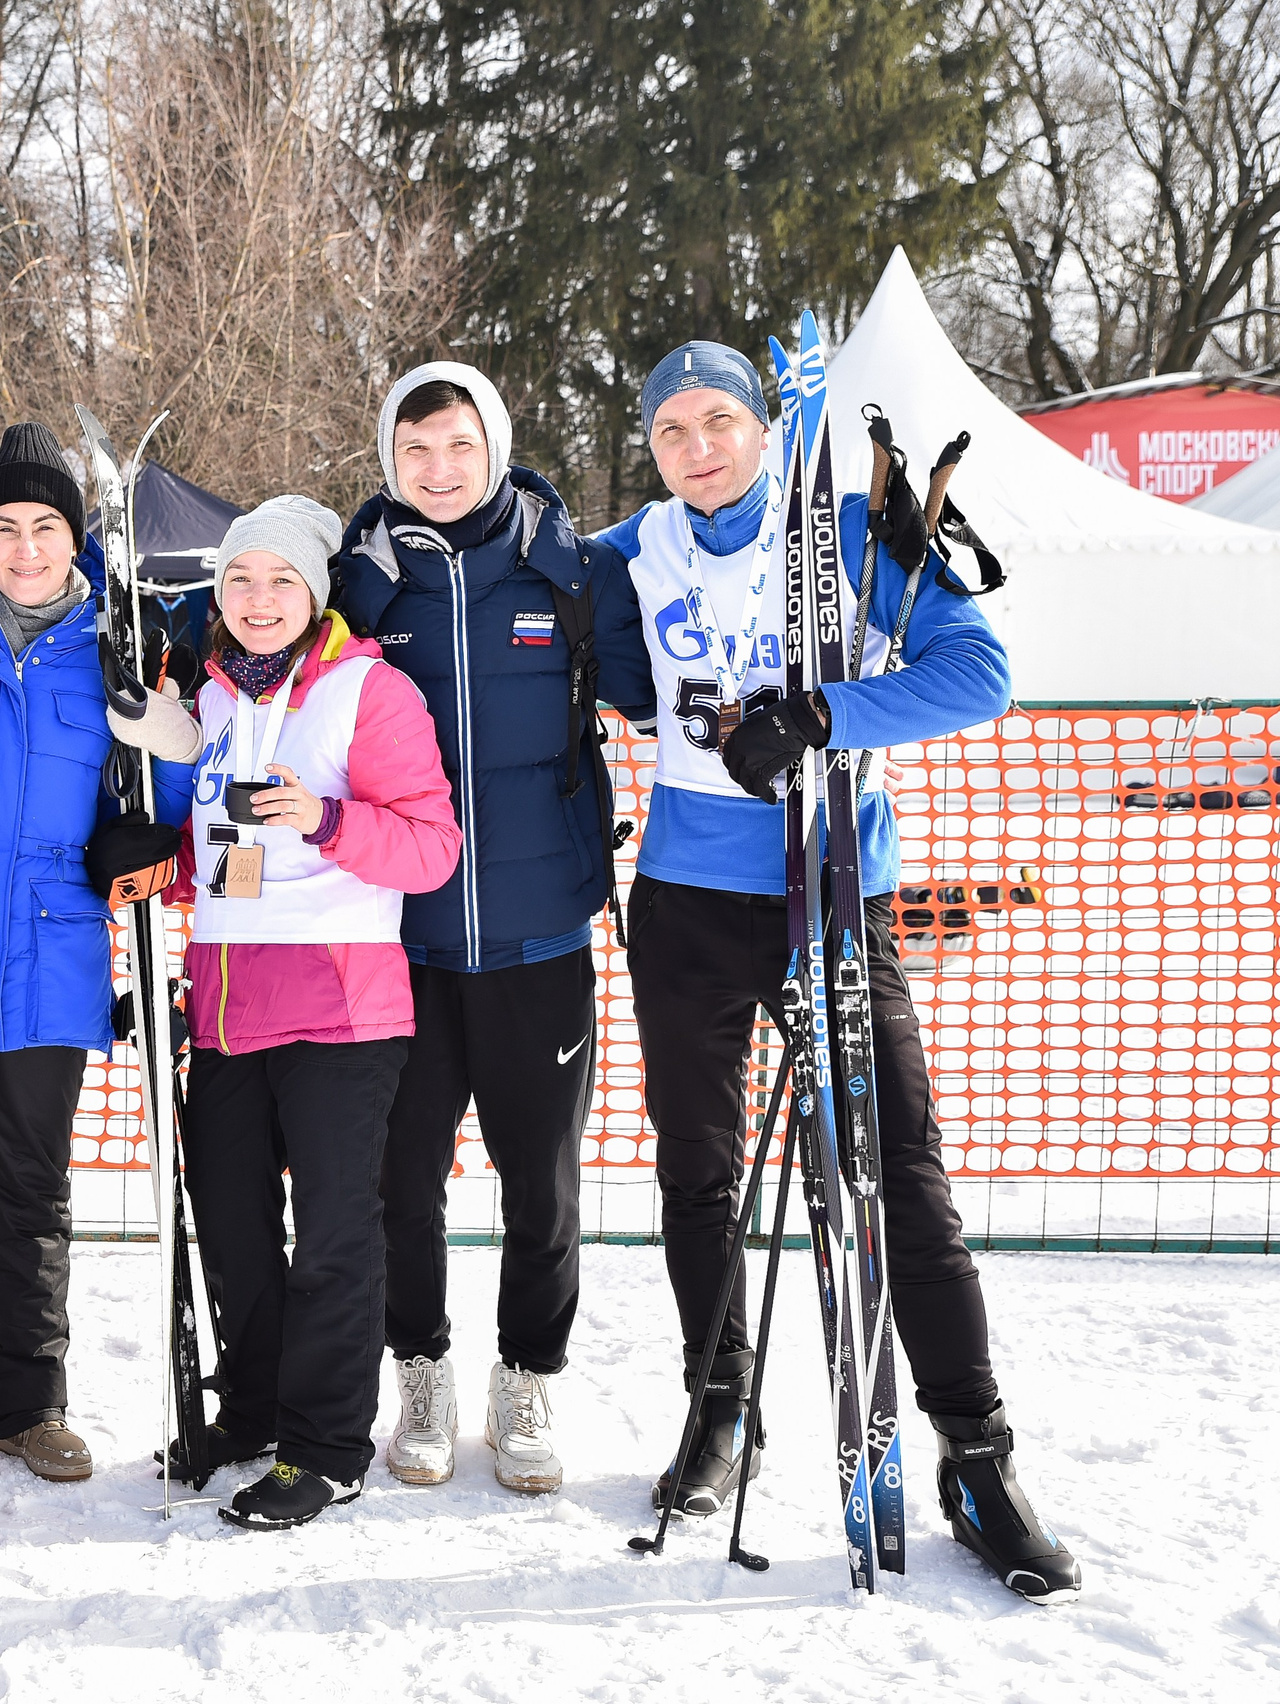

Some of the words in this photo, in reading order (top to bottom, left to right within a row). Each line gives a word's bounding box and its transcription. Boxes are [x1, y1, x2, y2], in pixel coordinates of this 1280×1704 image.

[1138, 463, 1218, 496] СПОРТ
[811, 508, 840, 644] salomon
[787, 529, 802, 666] salomon
[515, 613, 555, 621] РОССИЯ
[376, 633, 409, 645] OSCO
[838, 752, 850, 771] 8
[808, 940, 832, 1088] salomon
[867, 1411, 898, 1452] RS
[838, 1441, 861, 1486] RS
[964, 1446, 995, 1454] salomon
[884, 1462, 902, 1489] 8
[852, 1496, 866, 1523] 8
